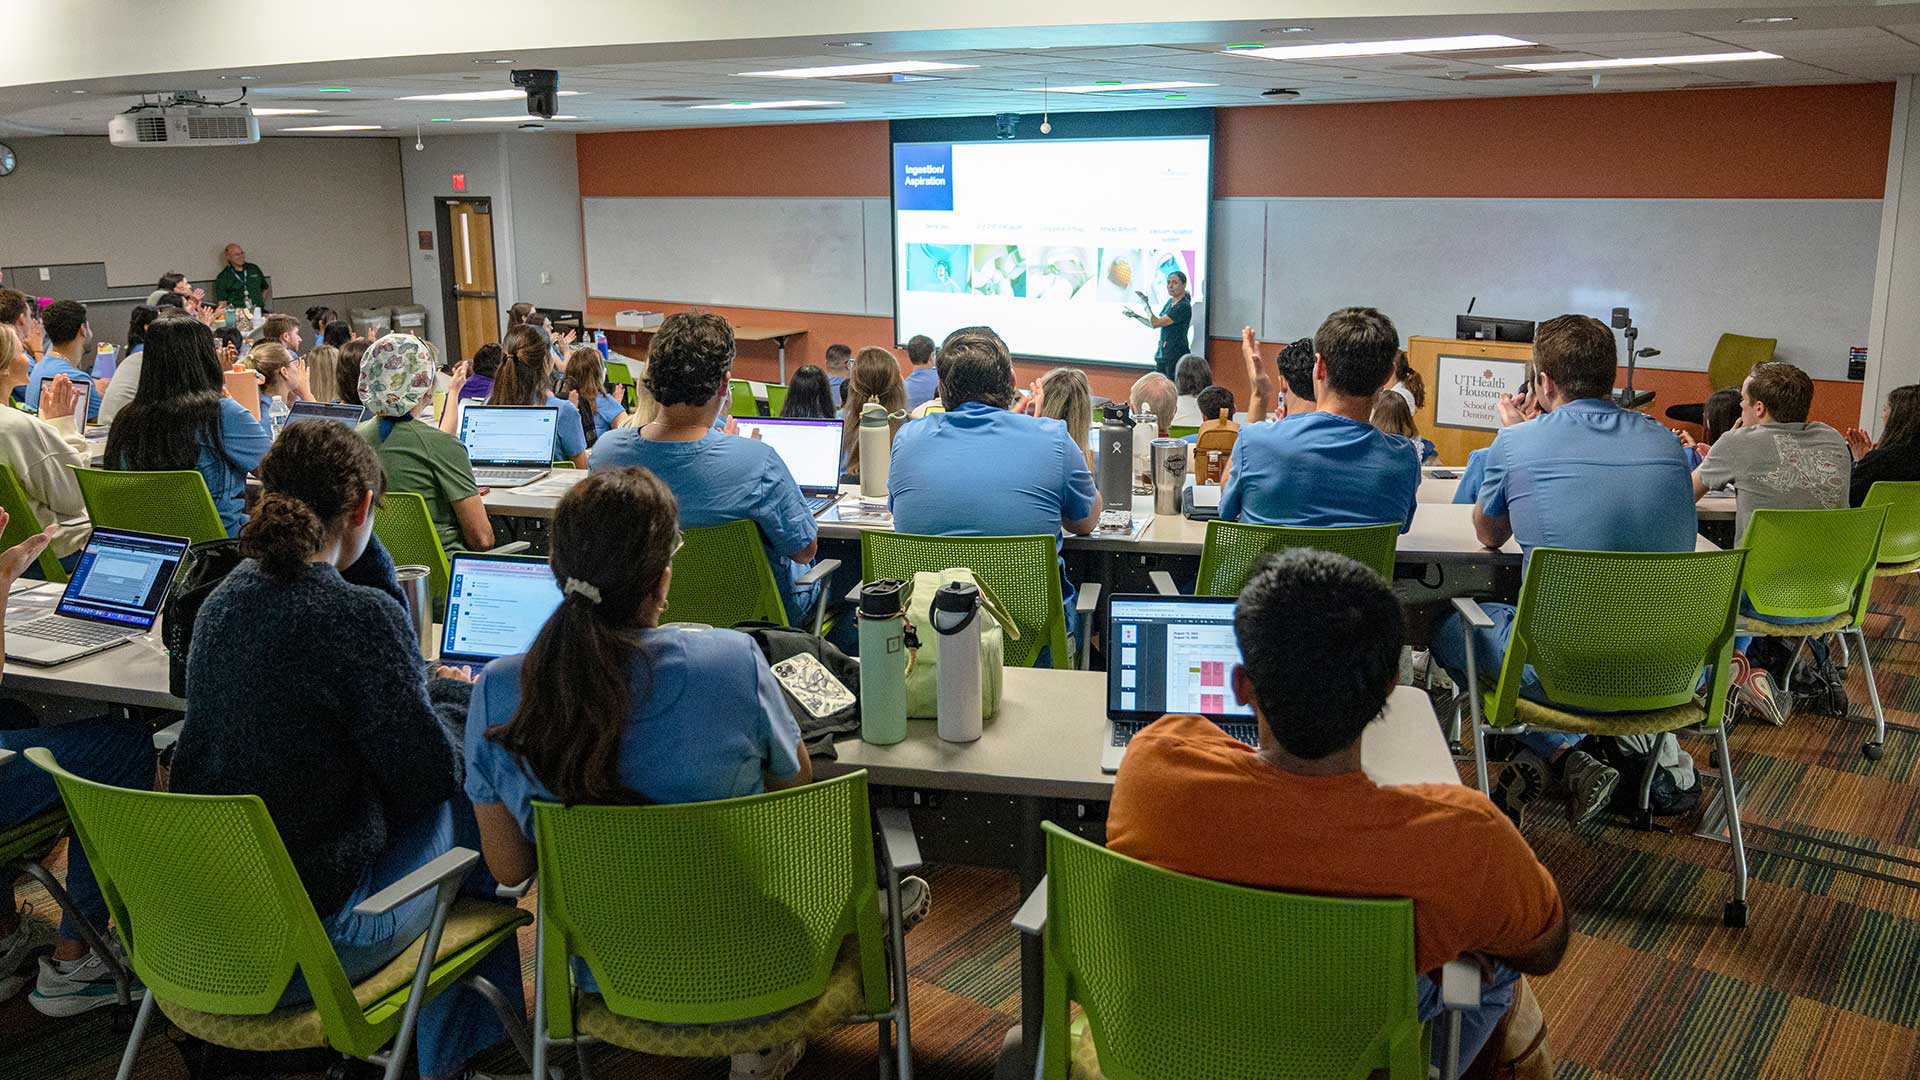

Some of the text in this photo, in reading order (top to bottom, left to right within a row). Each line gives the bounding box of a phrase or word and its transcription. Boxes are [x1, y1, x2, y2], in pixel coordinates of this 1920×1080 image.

[905, 164, 945, 176] Ingestion/
[904, 176, 946, 187] Aspiration
[1454, 374, 1505, 389] UTHealth
[1459, 386, 1500, 399] Houston
[1463, 400, 1496, 411] School of
[1462, 410, 1496, 422] Dentistry
